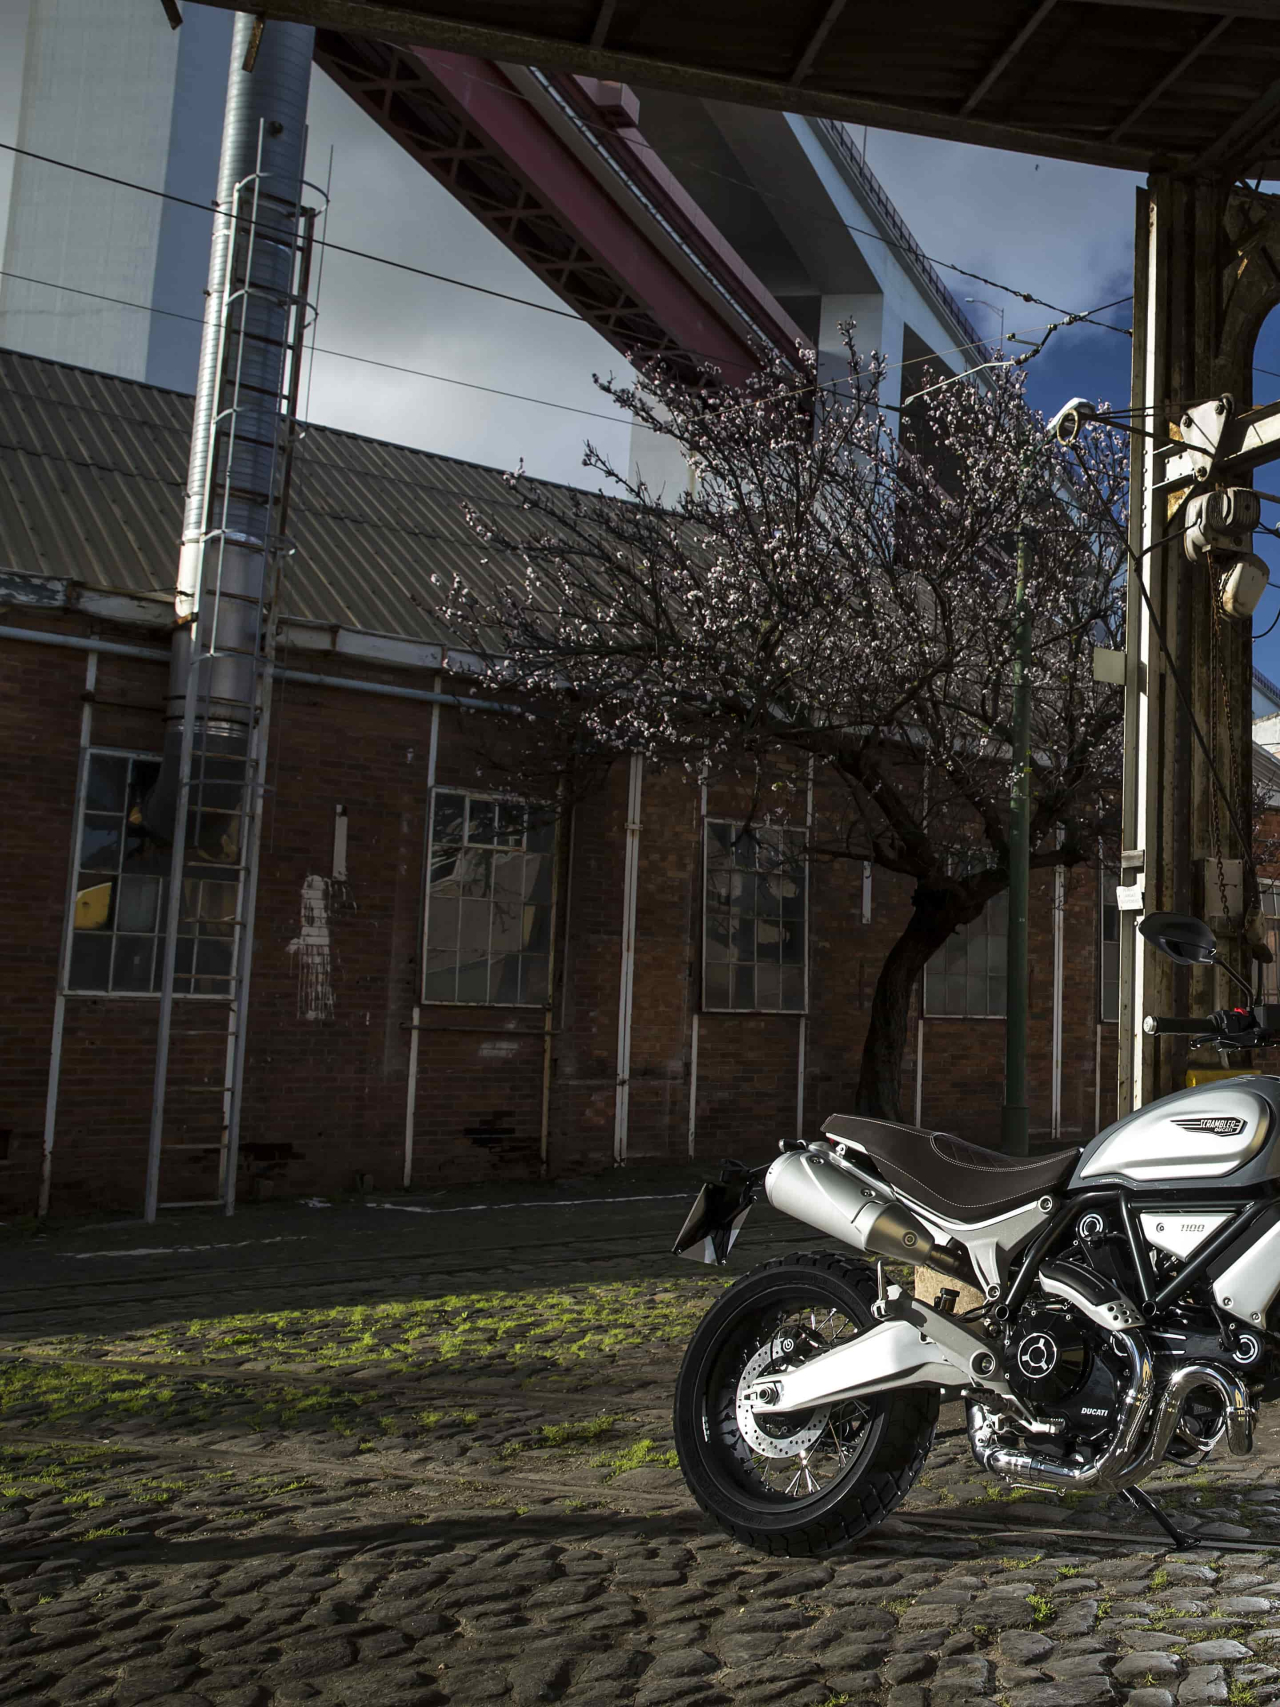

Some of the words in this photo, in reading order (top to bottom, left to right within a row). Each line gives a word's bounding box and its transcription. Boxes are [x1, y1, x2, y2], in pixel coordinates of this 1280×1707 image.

[1200, 1119, 1236, 1128] SCRAMBLER
[1180, 1223, 1205, 1232] 1100
[1081, 1407, 1109, 1417] DUCATI
